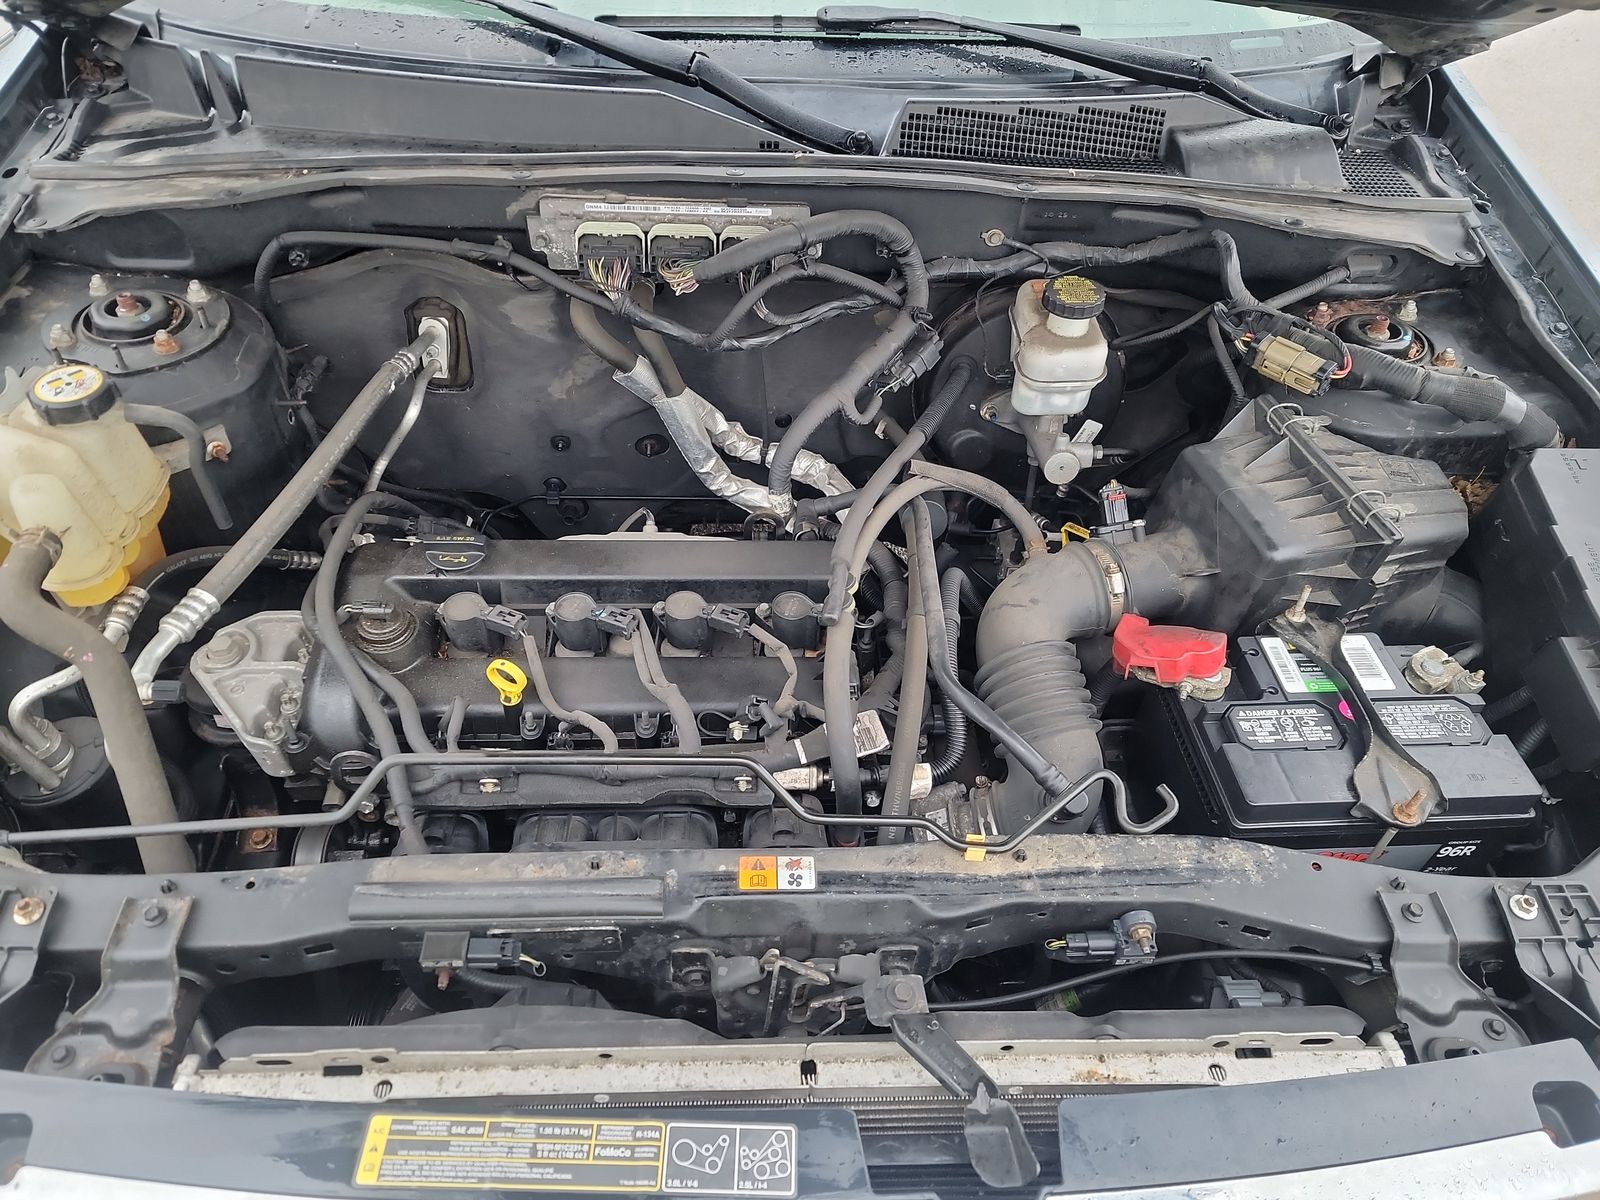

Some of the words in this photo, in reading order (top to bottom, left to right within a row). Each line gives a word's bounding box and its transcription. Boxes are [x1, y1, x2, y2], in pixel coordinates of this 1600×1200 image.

[1245, 709, 1280, 717] DANGER
[1287, 707, 1318, 716] POISON
[1436, 846, 1477, 857] 96R
[450, 1126, 466, 1135] SAE
[594, 1147, 631, 1158] FoMoCo
